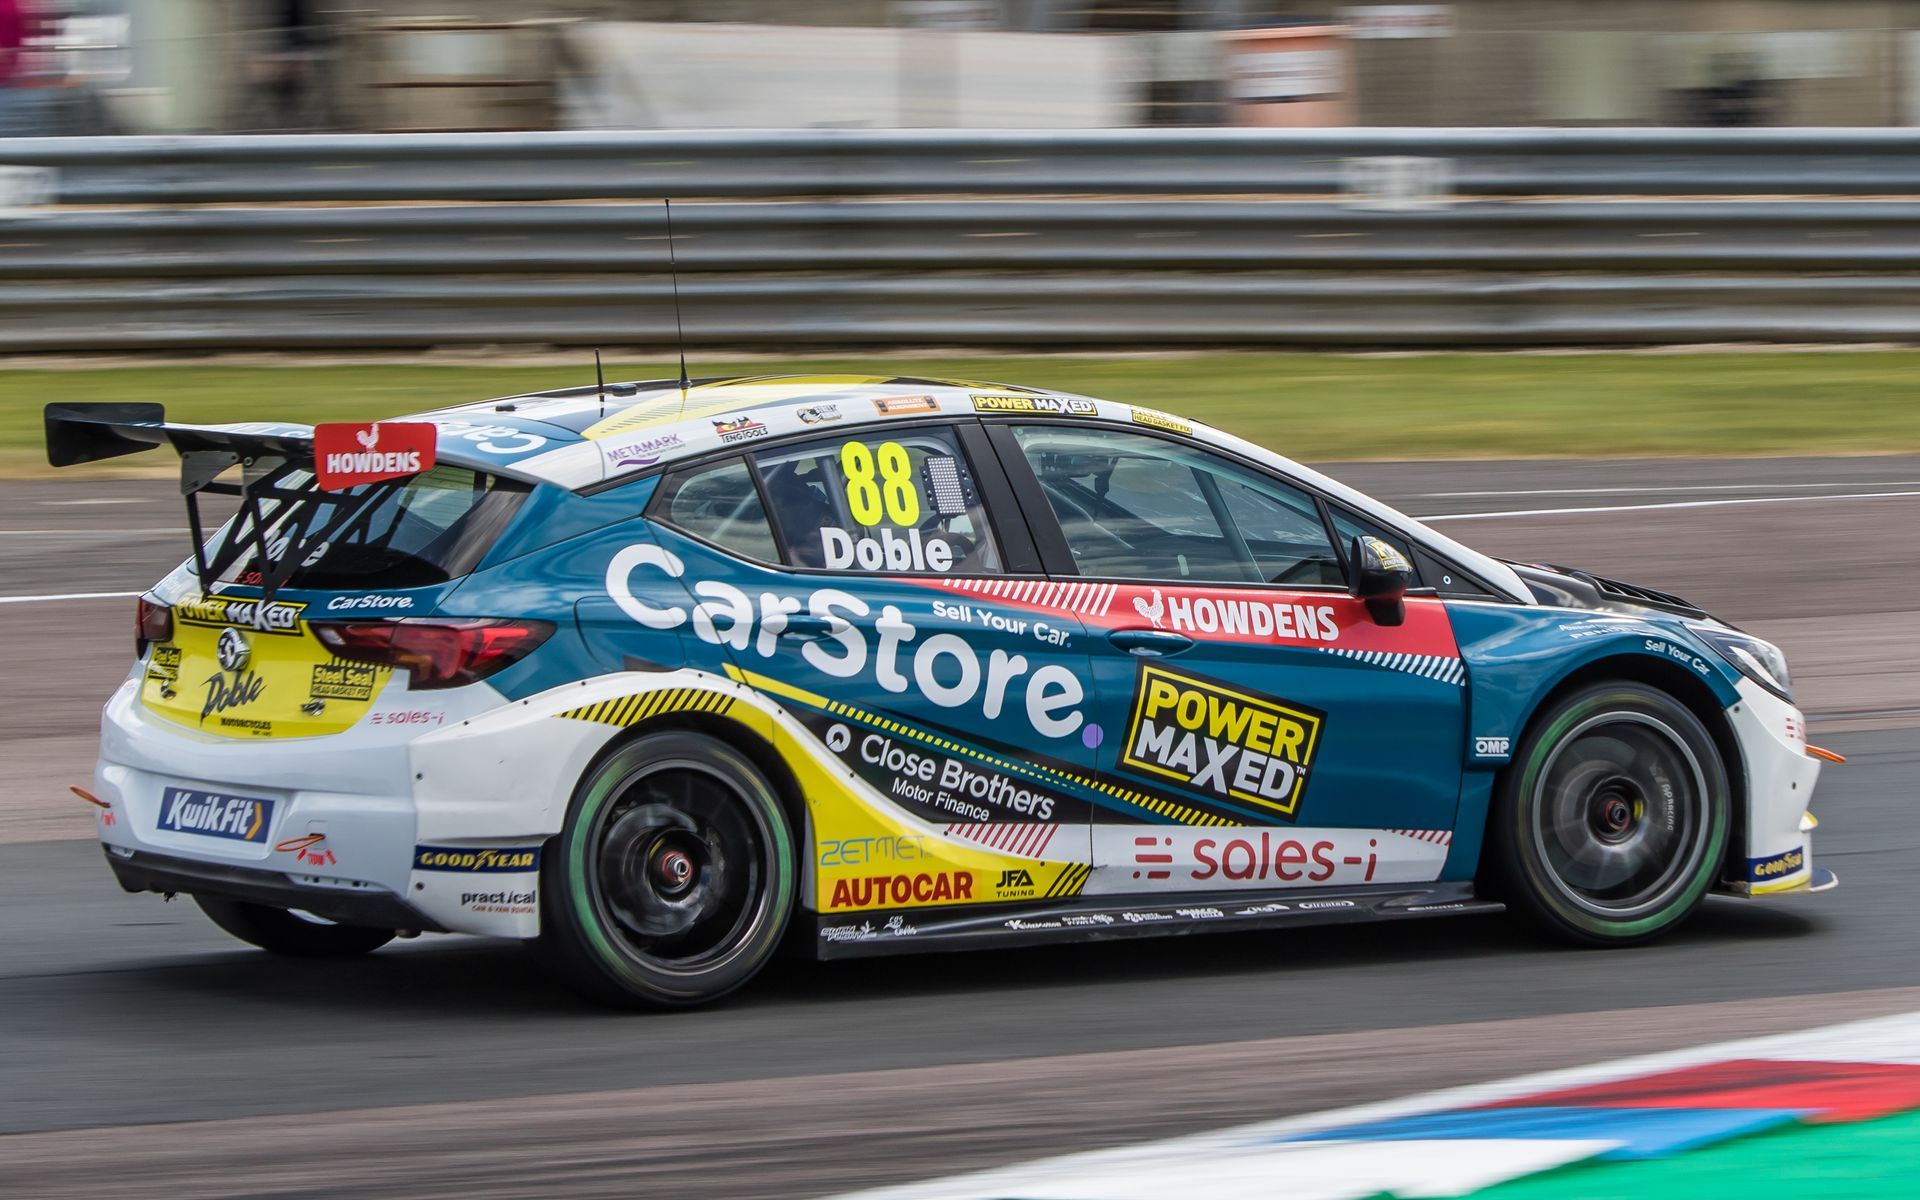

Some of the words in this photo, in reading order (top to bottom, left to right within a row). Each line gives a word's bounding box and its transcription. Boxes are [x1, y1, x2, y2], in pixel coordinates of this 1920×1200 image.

[975, 397, 1034, 410] POWER
[1034, 398, 1092, 413] MAXED
[327, 452, 421, 473] HOWDENS
[606, 433, 683, 462] METAMARK
[841, 441, 919, 526] 88
[820, 527, 953, 572] Doble
[932, 600, 972, 622] Sell
[976, 608, 1028, 635] Your
[1168, 597, 1340, 641] HOWDENS
[1645, 639, 1666, 654] Sell
[1668, 645, 1692, 663] Your
[314, 667, 344, 685] Steel
[346, 668, 374, 686] Seal
[385, 710, 446, 725] sales-i
[1146, 678, 1305, 763] POWER
[1135, 719, 1297, 800] MAXED
[1475, 740, 1509, 754] OMP
[861, 734, 936, 781] Close
[940, 758, 1056, 820] Brothers
[892, 777, 932, 807] Motor
[935, 791, 990, 822] Finance
[1190, 831, 1377, 882] sales-i
[830, 871, 974, 908] AUTOCAR
[996, 869, 1035, 889] JFA
[996, 890, 1035, 898] TUNING
[461, 889, 536, 906] practical
